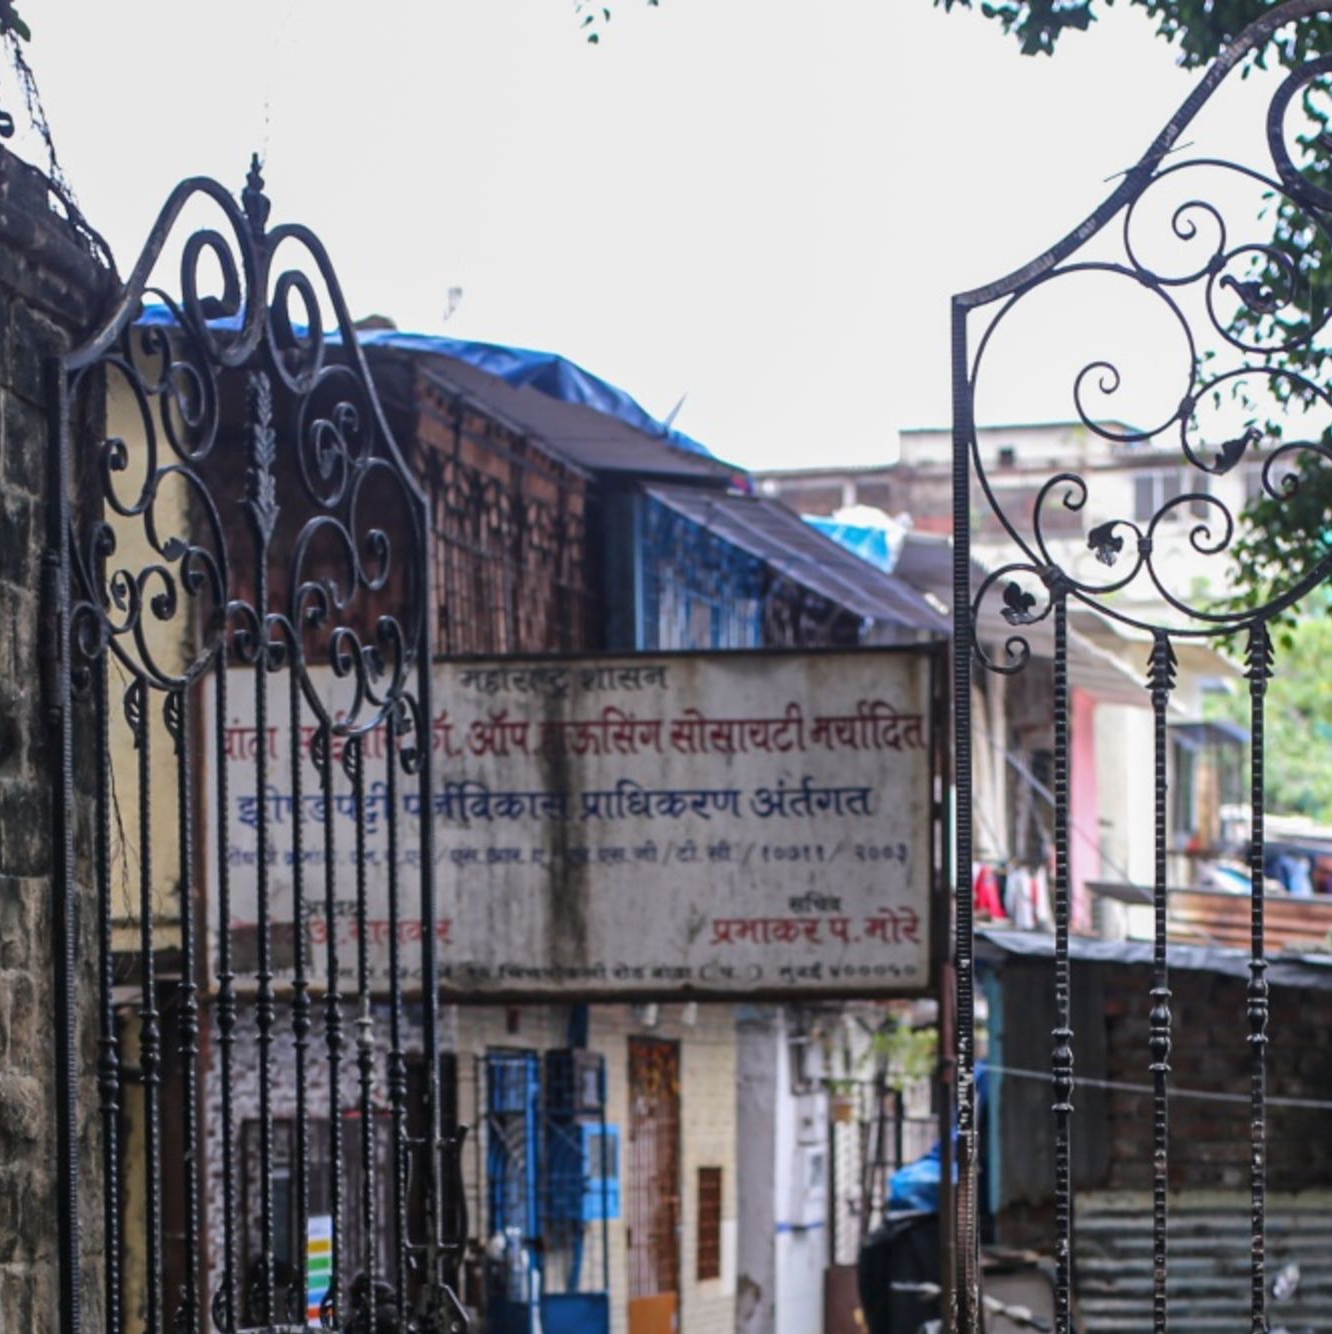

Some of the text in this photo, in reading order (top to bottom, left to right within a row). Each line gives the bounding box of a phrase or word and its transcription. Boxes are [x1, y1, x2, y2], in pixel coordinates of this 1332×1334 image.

[580, 664, 669, 690] शासन
[670, 702, 807, 754] सोसायटी
[812, 699, 925, 752] मर्यादित
[579, 778, 741, 822] प्राधिकरण
[710, 917, 824, 946] प्रभाकर
